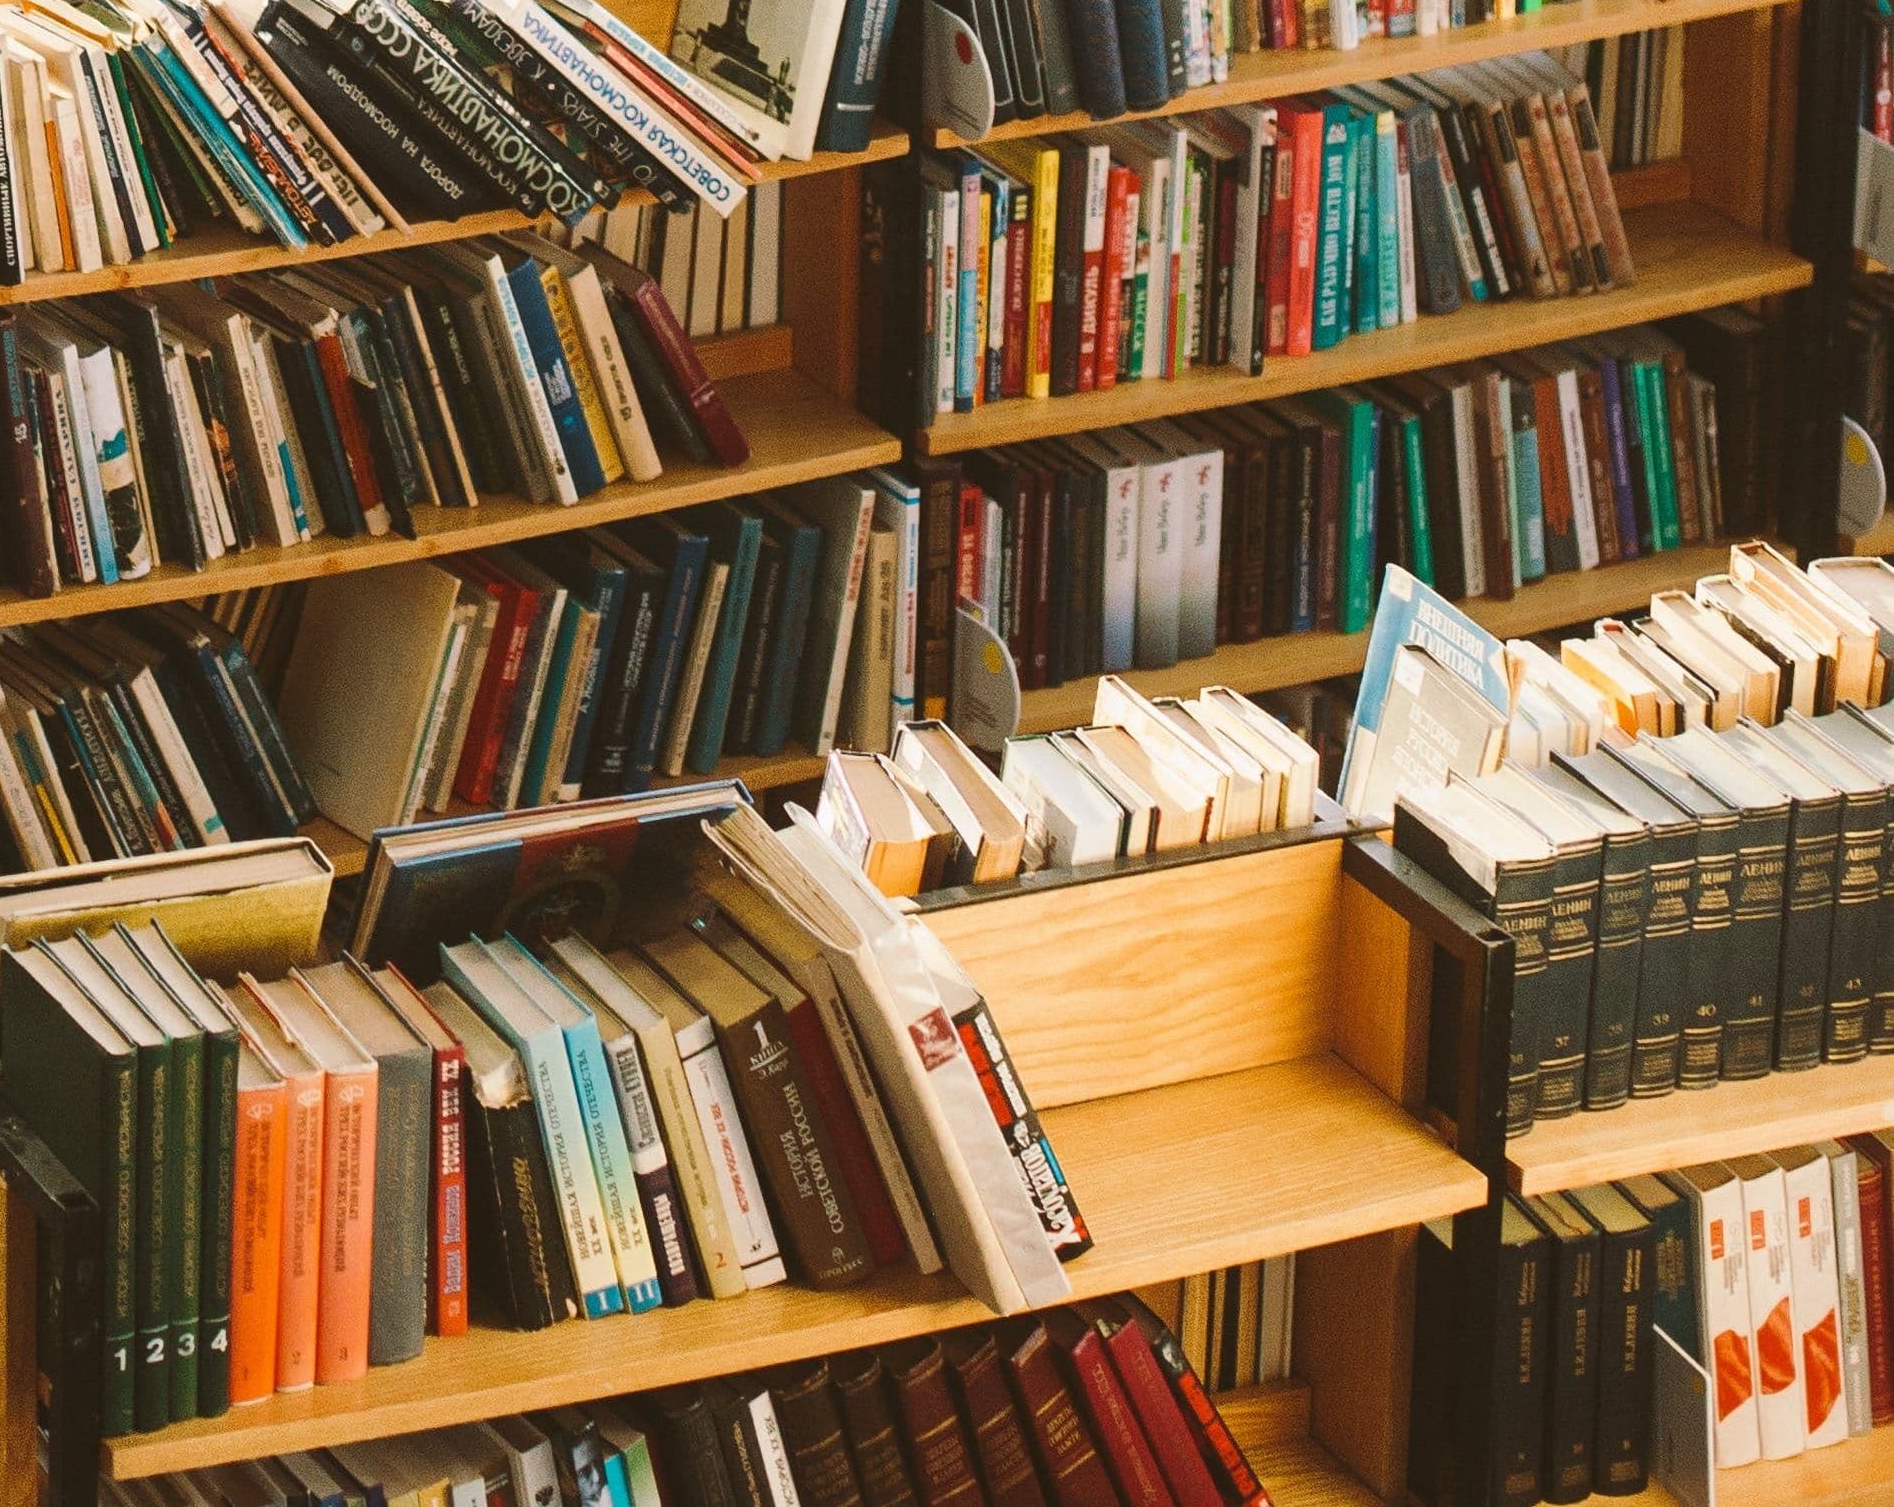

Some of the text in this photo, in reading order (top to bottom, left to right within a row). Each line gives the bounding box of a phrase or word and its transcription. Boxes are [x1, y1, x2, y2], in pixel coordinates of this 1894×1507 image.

[517, 9, 650, 131] КОСМОНАВТИКА
[321, 63, 465, 201] ДОРОГА НА КОСМОДРОМ
[402, 47, 589, 223] КОСМОНАВТИКА
[410, 96, 524, 196] КОСМОНАВТИКА
[555, 89, 608, 140] STARS
[239, 131, 321, 226] АВТОМОБИЛЬ
[603, 136, 634, 166] THE
[645, 122, 733, 204] СОВЕТСКАЯ
[1326, 155, 1342, 182] ДОМ
[1324, 186, 1341, 231] ВЕСТИ
[1081, 265, 1098, 334] ДИКУЛЬ
[1320, 297, 1335, 326] КАК
[1409, 619, 1486, 691] ПОЛИТИКА
[754, 1020, 768, 1049] 1
[575, 1048, 600, 1119] ОТЕЧЕСТВА
[536, 1061, 589, 1261] НОВЕЙШАЯ ИСТОРИЯ ОТЕЧЕСТВА
[591, 1121, 615, 1179] ИСТОРИЯ
[780, 1128, 813, 1198] ИСТОРИЯ
[781, 1080, 846, 1236] СОВЕТСКОЙ РОССИИ
[1017, 1138, 1082, 1250] Хасбулатов
[714, 1251, 727, 1269] 2
[114, 1348, 126, 1371] 1
[146, 1338, 164, 1363] 2
[177, 1333, 195, 1356] 3
[211, 1329, 228, 1352] 4
